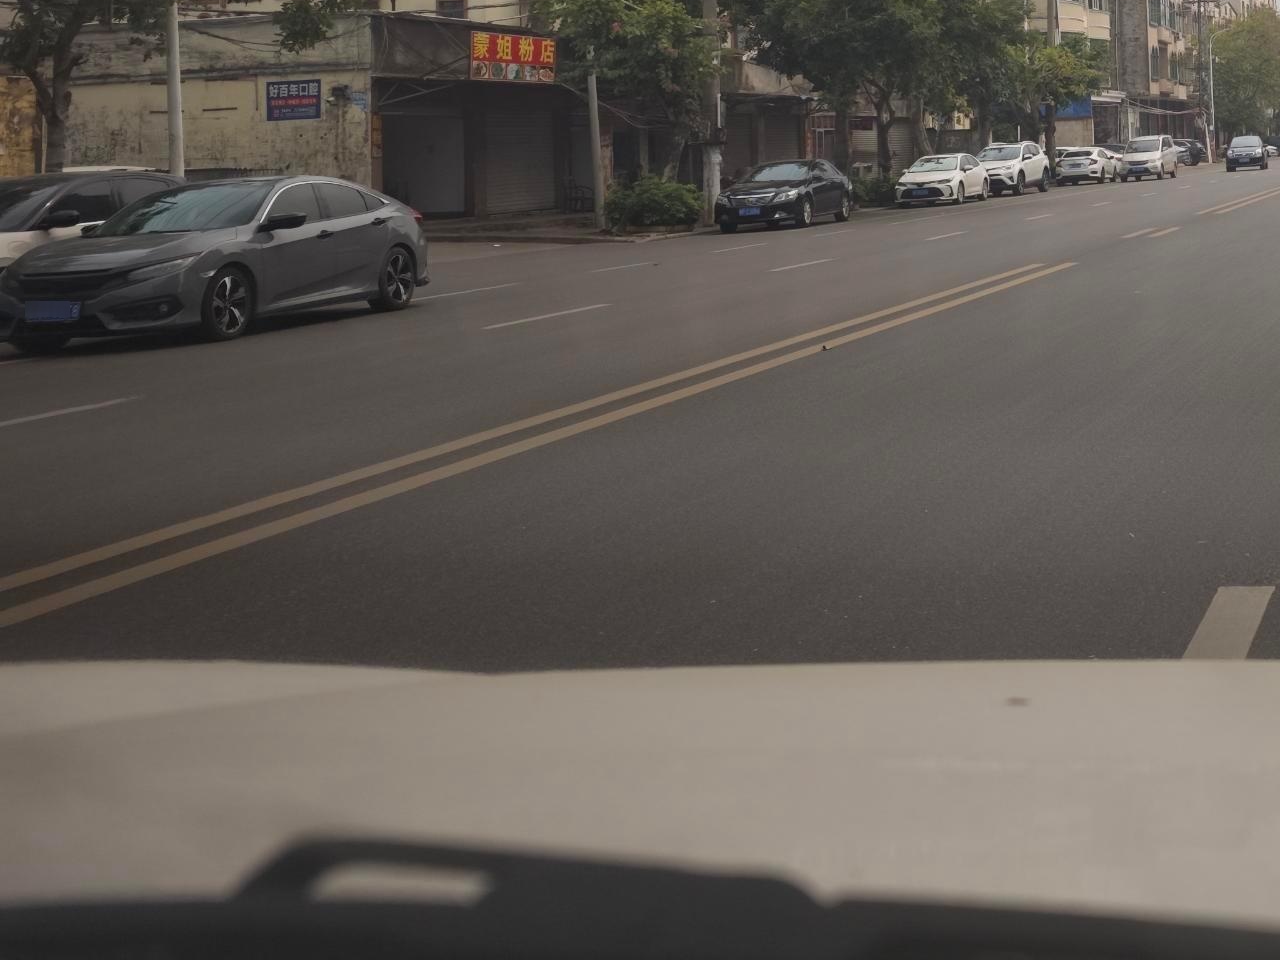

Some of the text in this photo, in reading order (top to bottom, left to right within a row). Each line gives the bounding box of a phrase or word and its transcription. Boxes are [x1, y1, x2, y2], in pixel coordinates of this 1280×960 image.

[474, 32, 555, 63] 蒙姐粉店
[269, 83, 318, 97] 好百年口腔
